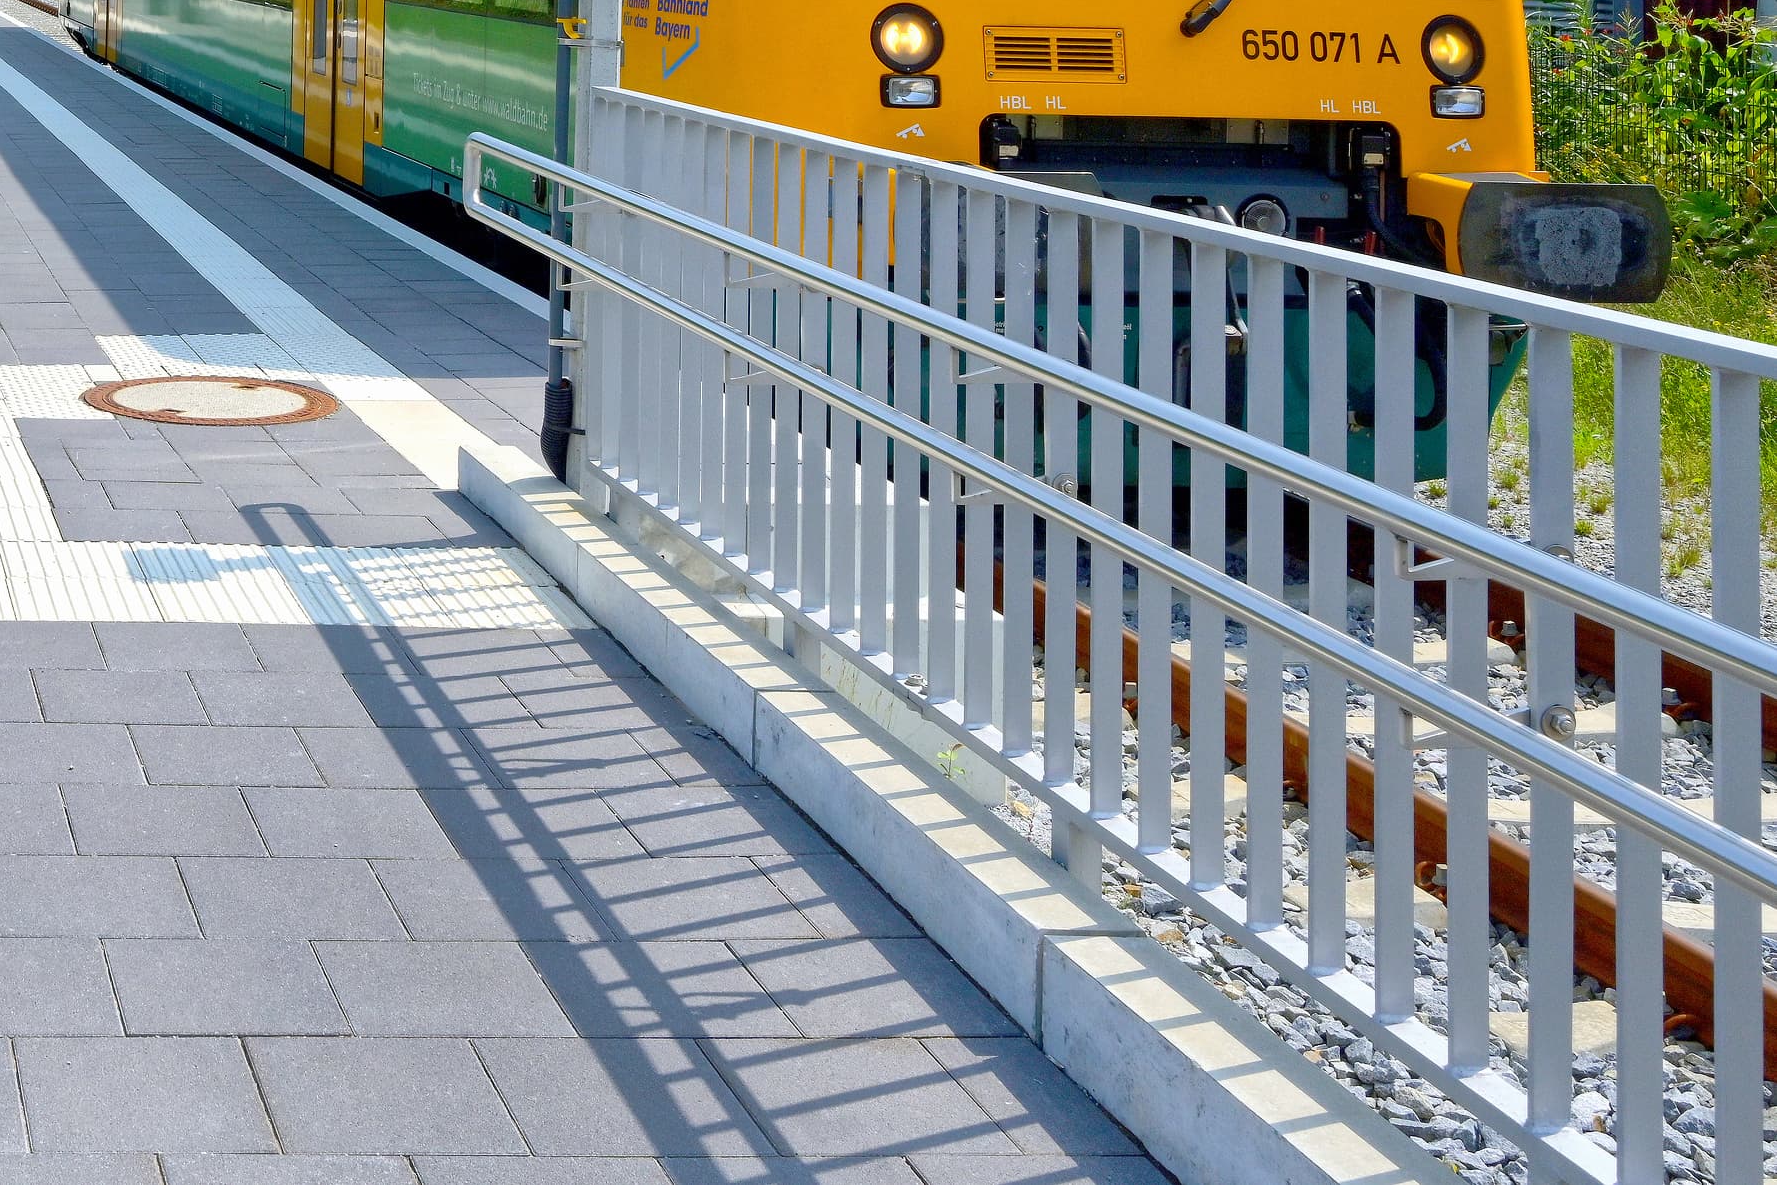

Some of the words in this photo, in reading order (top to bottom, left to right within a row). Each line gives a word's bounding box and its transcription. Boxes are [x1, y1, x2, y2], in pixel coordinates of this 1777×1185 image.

[634, 14, 648, 28] das
[655, 16, 691, 42] Bayern
[1242, 29, 1299, 62] 650
[1310, 31, 1361, 64] 071
[1377, 33, 1401, 65] A
[413, 72, 433, 98] Tickets
[442, 80, 455, 109] Zug
[456, 83, 462, 105] &
[462, 90, 481, 112] unter
[482, 96, 549, 132] www.waldbahn.de
[999, 95, 1032, 110] HBL
[1045, 96, 1067, 111] HL
[1319, 98, 1340, 114] HL
[1351, 99, 1382, 115] HBL
